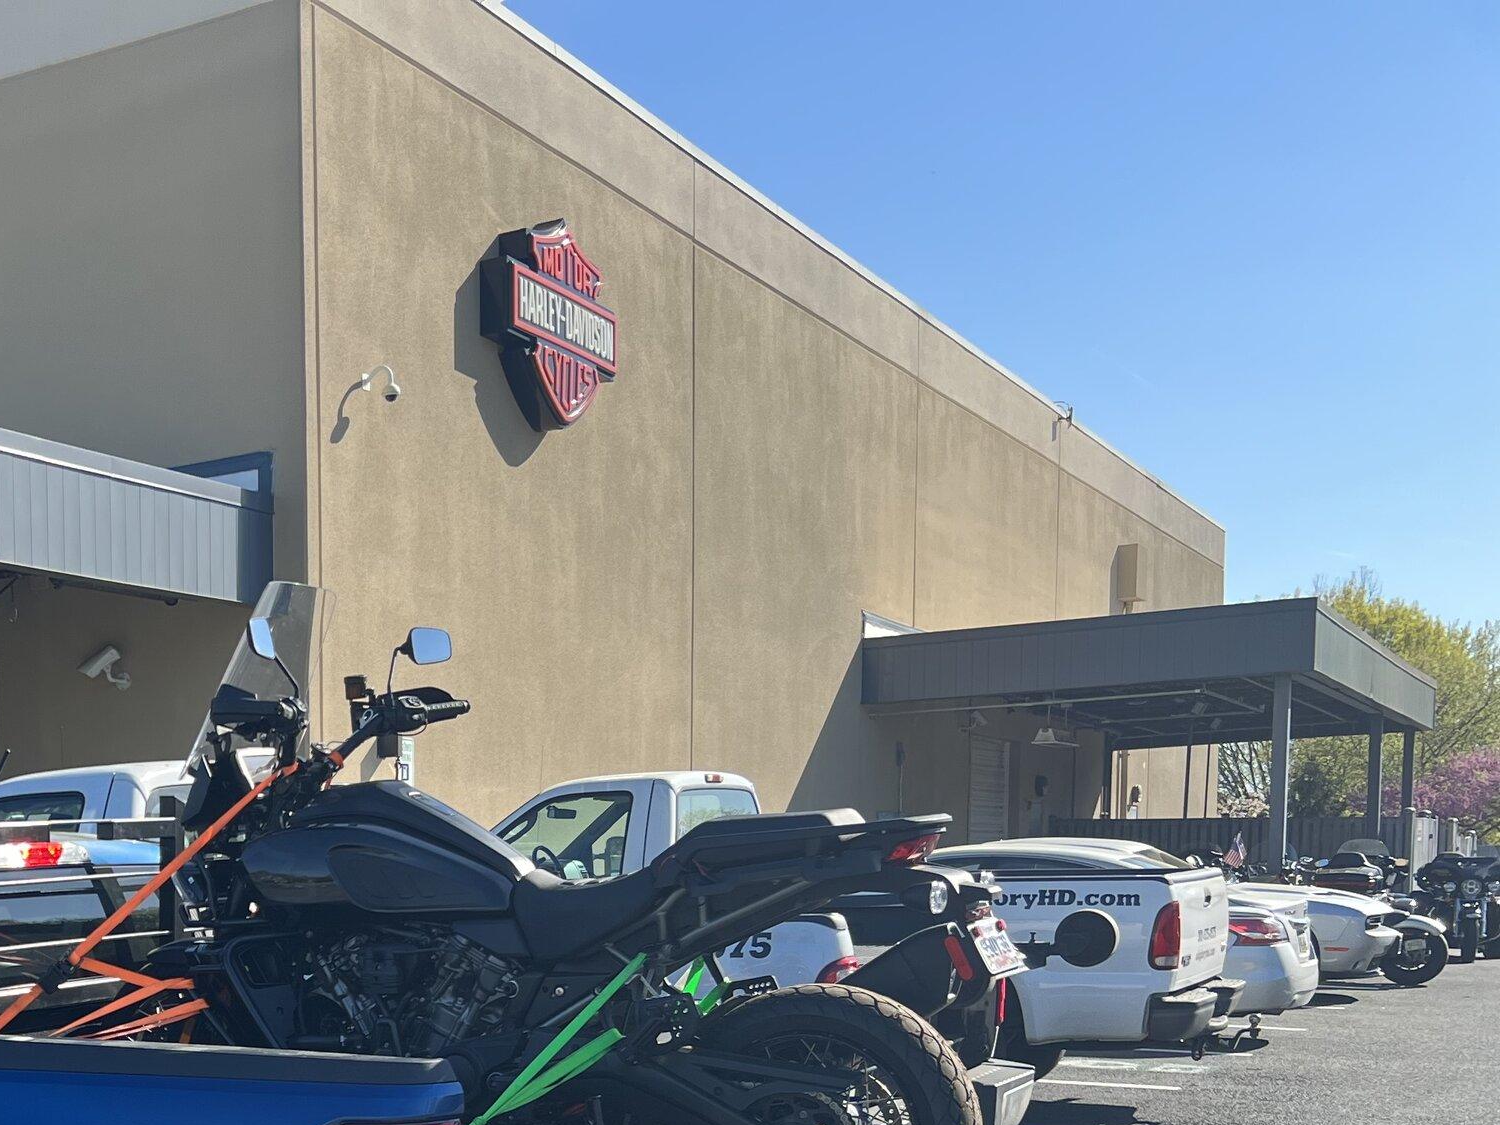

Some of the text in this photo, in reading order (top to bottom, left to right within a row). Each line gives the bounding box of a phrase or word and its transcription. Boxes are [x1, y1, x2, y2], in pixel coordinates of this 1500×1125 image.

[542, 246, 593, 297] MOTOR
[518, 276, 615, 362] HARLEY-DAVIDSON
[544, 346, 592, 409] CYCLES
[989, 889, 1142, 910] oryHD.com
